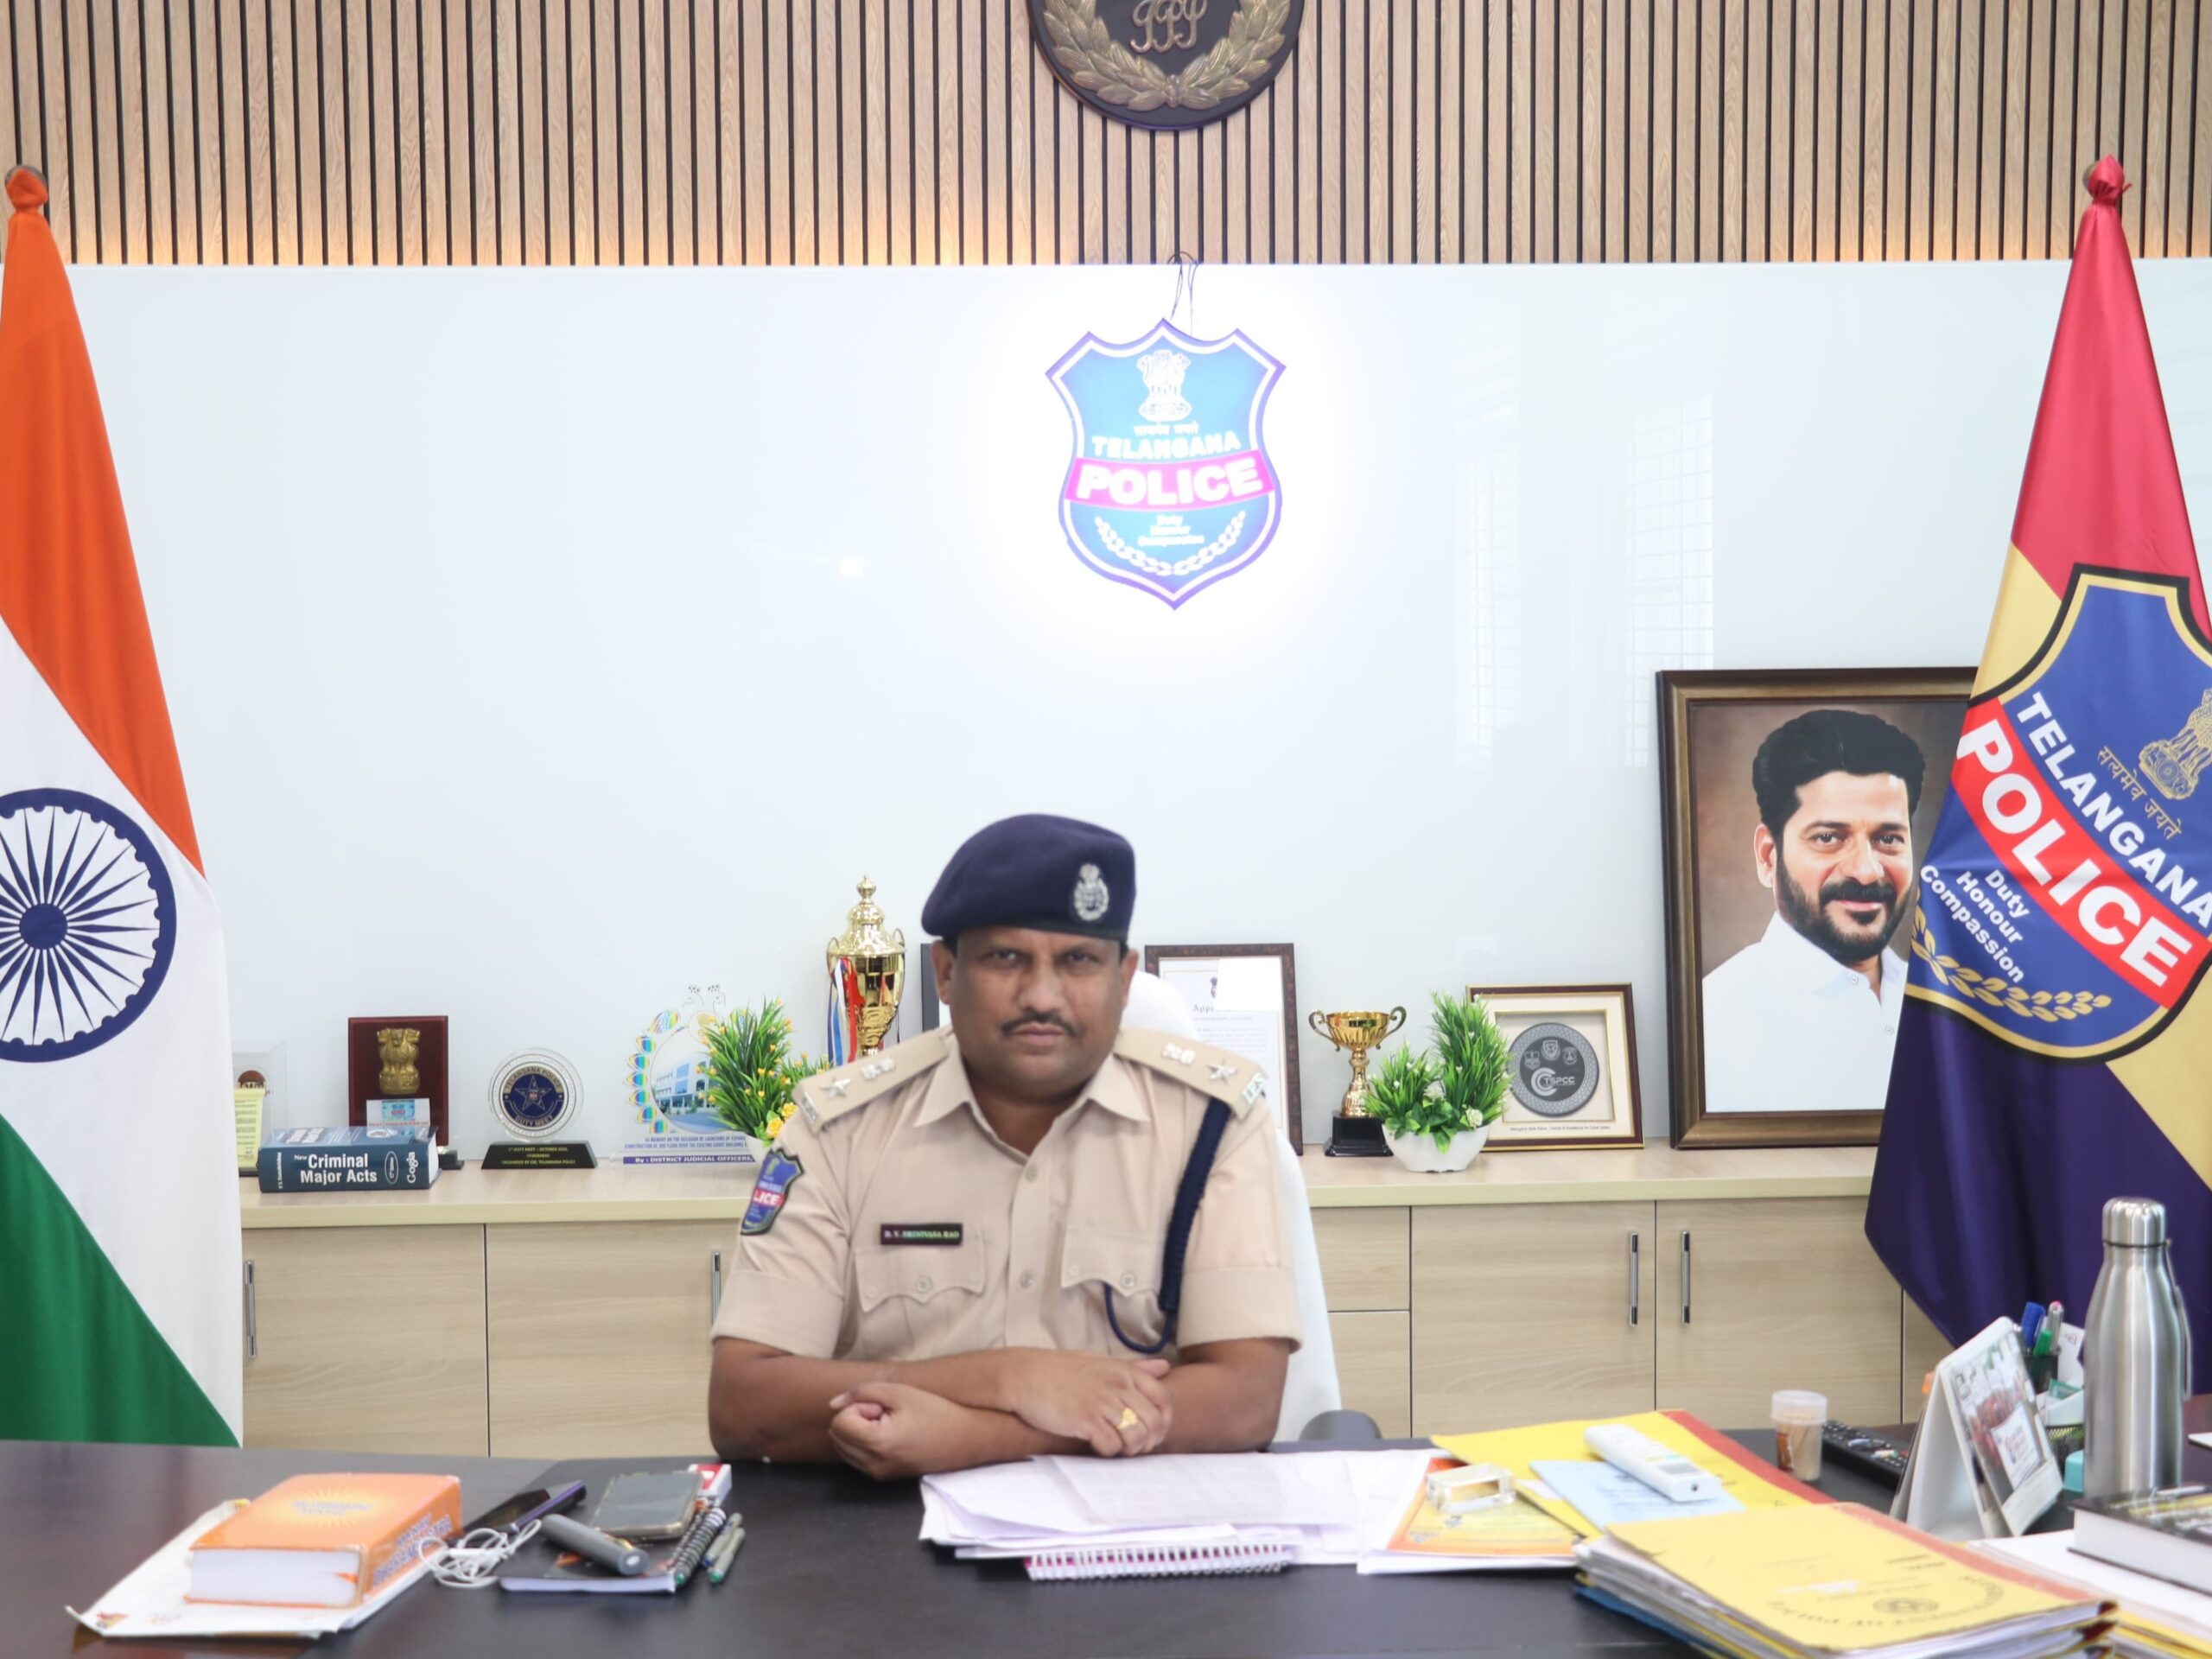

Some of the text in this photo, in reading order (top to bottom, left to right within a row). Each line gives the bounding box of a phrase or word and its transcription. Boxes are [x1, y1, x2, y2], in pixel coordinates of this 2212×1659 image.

[1092, 430, 1242, 459] TELANGANA
[1076, 457, 1263, 505] POLICE
[2017, 691, 2212, 928] TELANGANA
[2097, 746, 2183, 840] सत्यमेव जयते
[1956, 719, 2193, 988] POLICE
[1955, 871, 2023, 944] Honour
[1984, 869, 2030, 918] Duty
[1919, 865, 2024, 983] Compassion
[505, 1066, 541, 1089] TELANGANA
[300, 1169, 378, 1185] Major Acts
[308, 1154, 368, 1169] Criminal
[406, 1151, 418, 1184] Gogia
[753, 1191, 779, 1205] LICE
